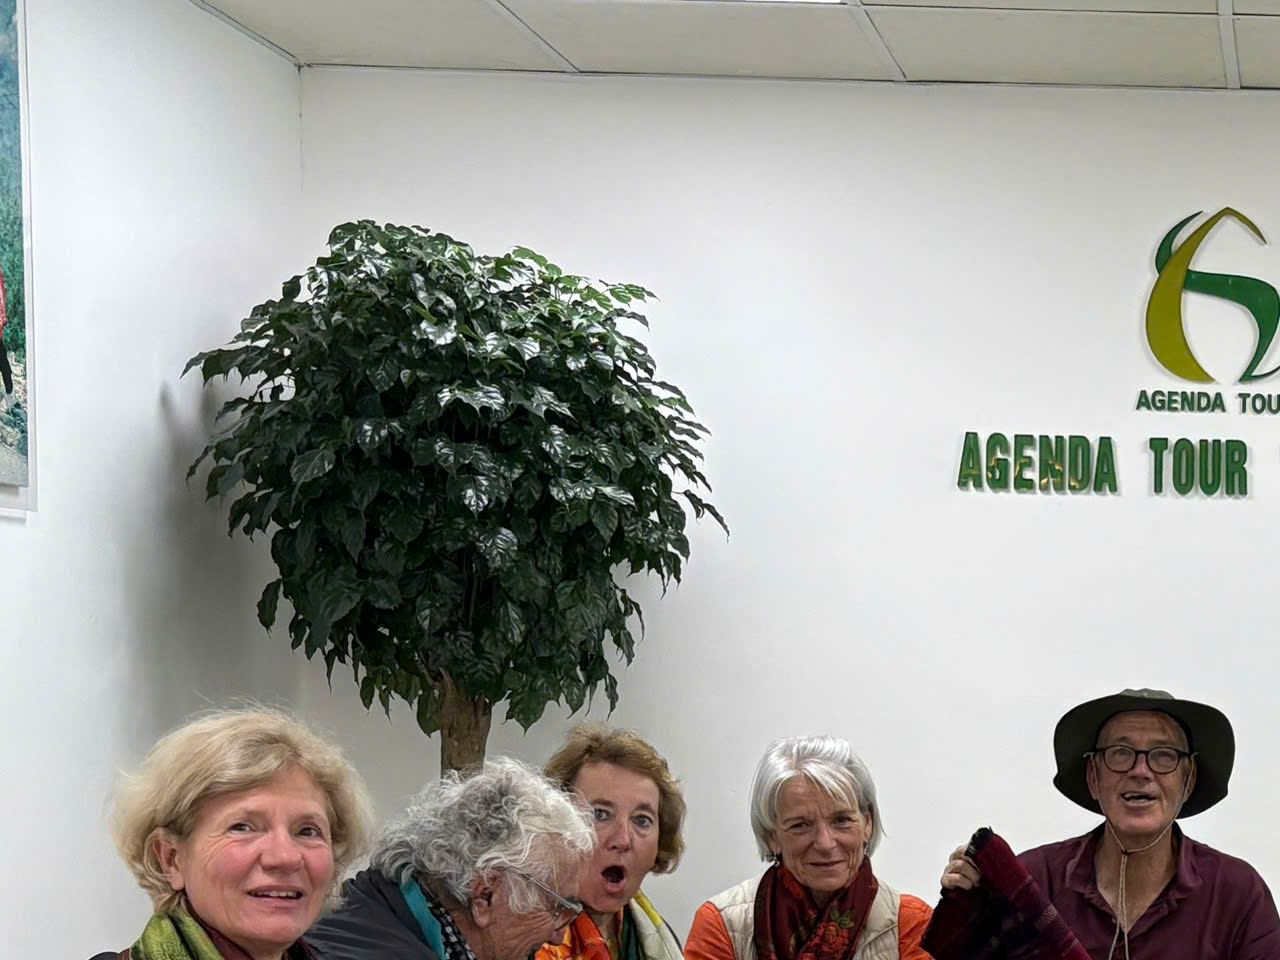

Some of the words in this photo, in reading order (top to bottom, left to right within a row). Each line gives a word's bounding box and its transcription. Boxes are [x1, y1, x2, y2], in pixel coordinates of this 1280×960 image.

[1136, 390, 1226, 414] AGENDA
[957, 431, 1119, 494] AGENDA
[1149, 437, 1248, 497] TOUR
